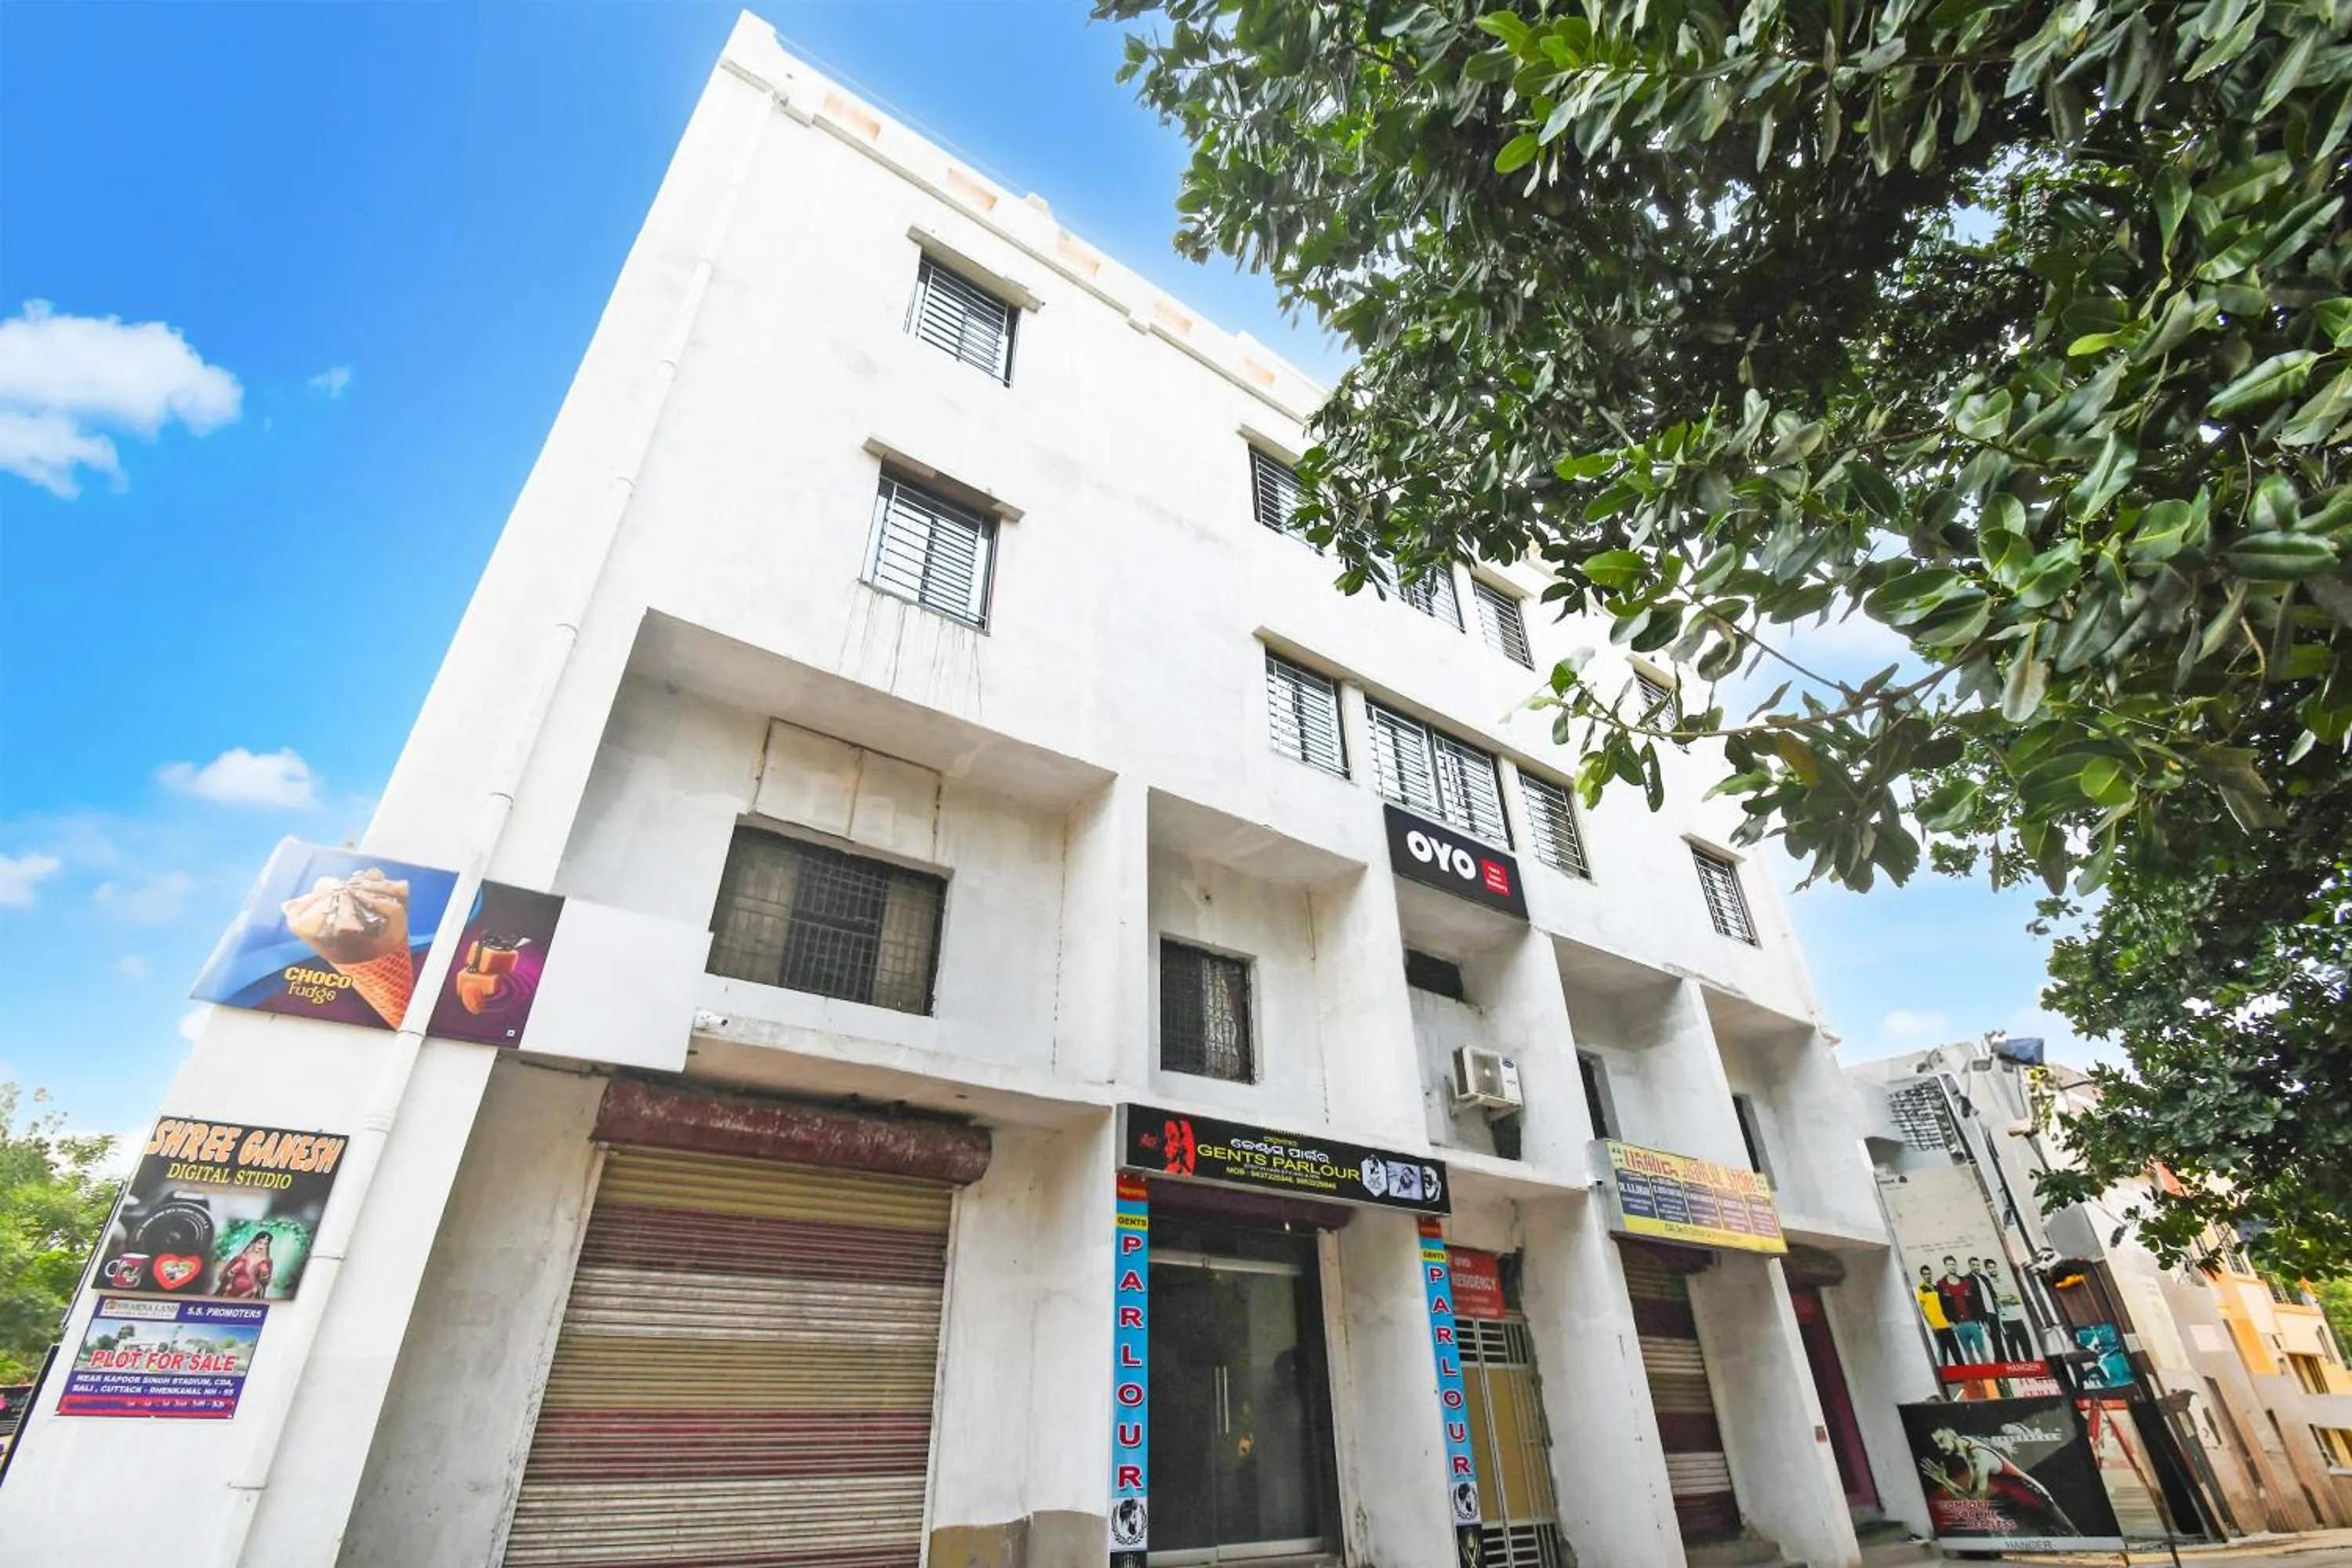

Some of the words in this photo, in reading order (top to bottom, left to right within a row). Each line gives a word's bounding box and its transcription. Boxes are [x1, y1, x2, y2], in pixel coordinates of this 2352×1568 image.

[1406, 830, 1476, 880] OYO
[285, 966, 353, 989] CHOCO
[288, 982, 336, 1004] fudge
[144, 1120, 242, 1163] SHREE
[238, 1130, 345, 1174] GANESH
[1197, 1144, 1267, 1166] GENTS
[1272, 1156, 1361, 1181] PARLOUR
[166, 1163, 230, 1185] DIGITAL
[234, 1169, 292, 1189] STUDIO
[1117, 1216, 1146, 1227] GENTS
[206, 1307, 262, 1319] PROMOTERS
[91, 1349, 143, 1369] PLOT
[146, 1351, 185, 1370] FOR
[188, 1353, 238, 1372] SALE
[1117, 1234, 1145, 1490] PARLOUR
[1428, 1266, 1471, 1475] PARLOUR
